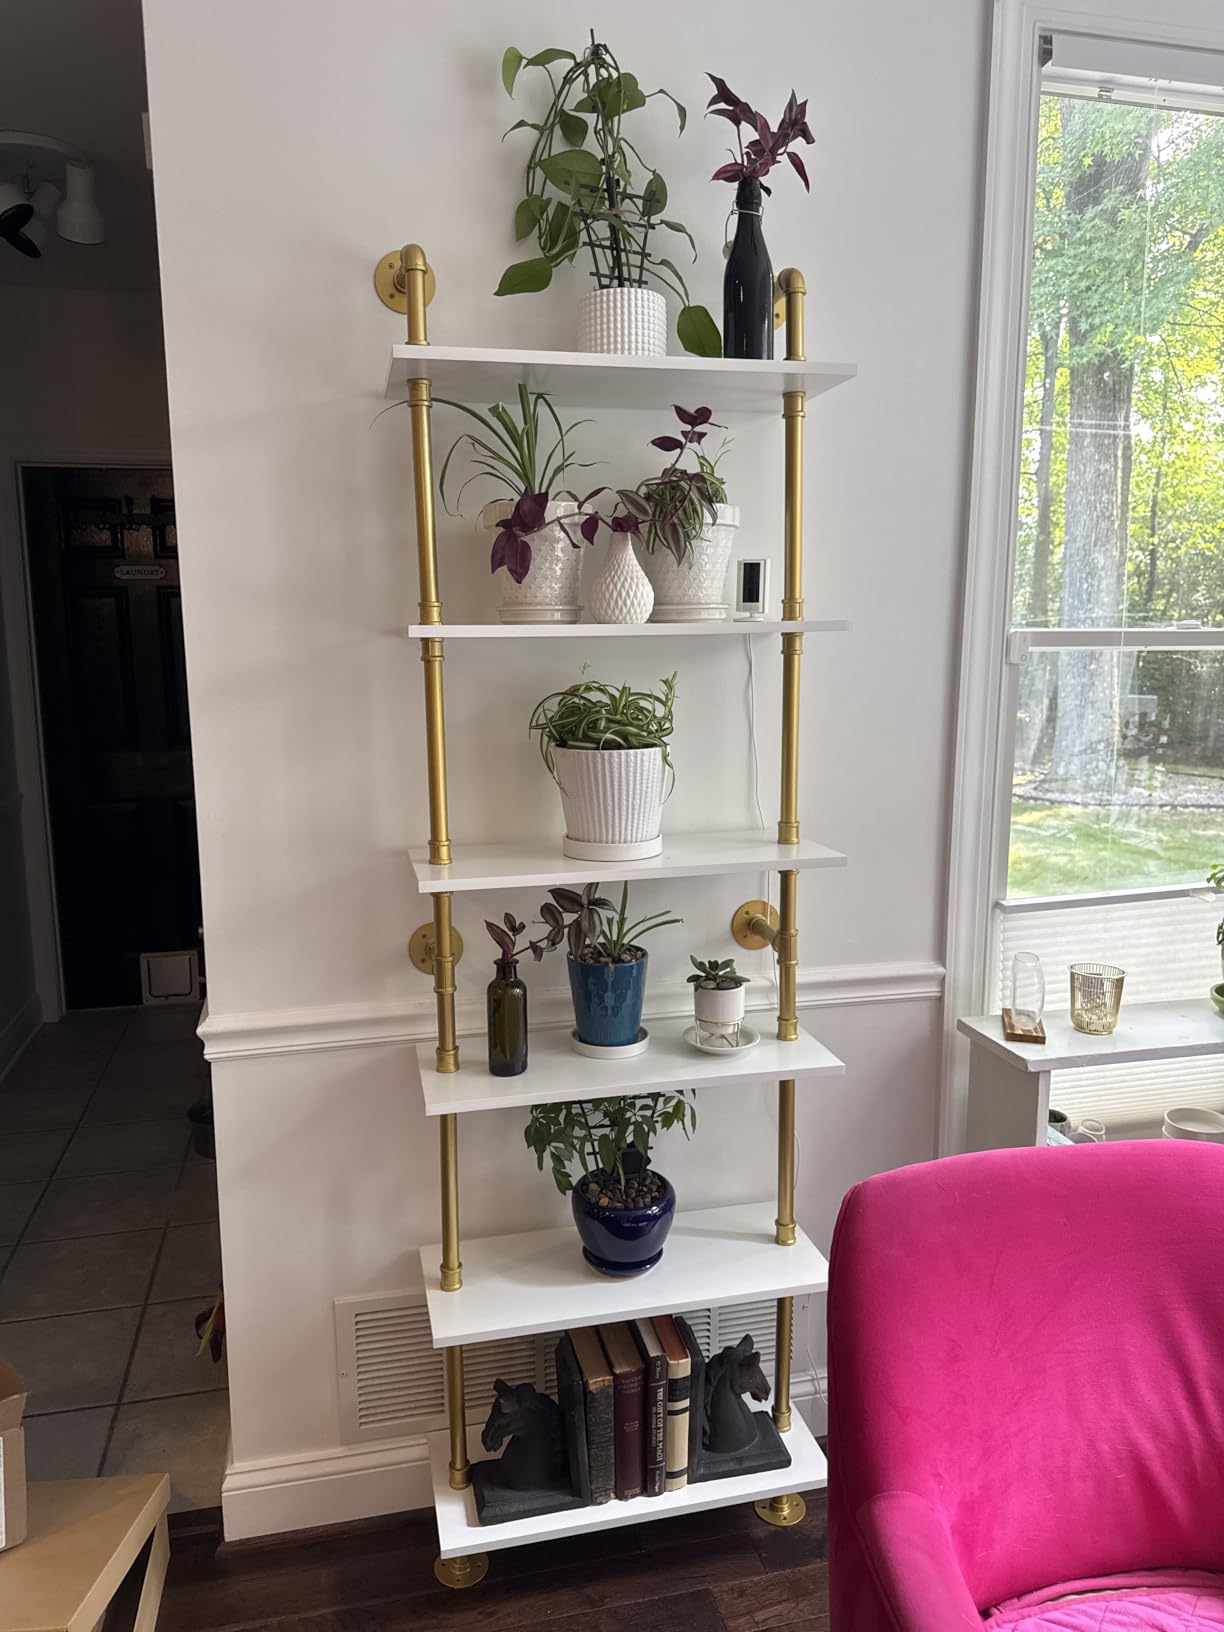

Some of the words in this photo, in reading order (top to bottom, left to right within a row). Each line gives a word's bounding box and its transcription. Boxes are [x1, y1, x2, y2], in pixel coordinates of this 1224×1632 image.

[120, 567, 159, 576] LAUNDRY
[656, 1387, 664, 1401] THE
[656, 1401, 664, 1417] GIFT
[656, 1418, 664, 1428] OF
[656, 1428, 664, 1442] THE
[656, 1442, 664, 1462] MAGI
